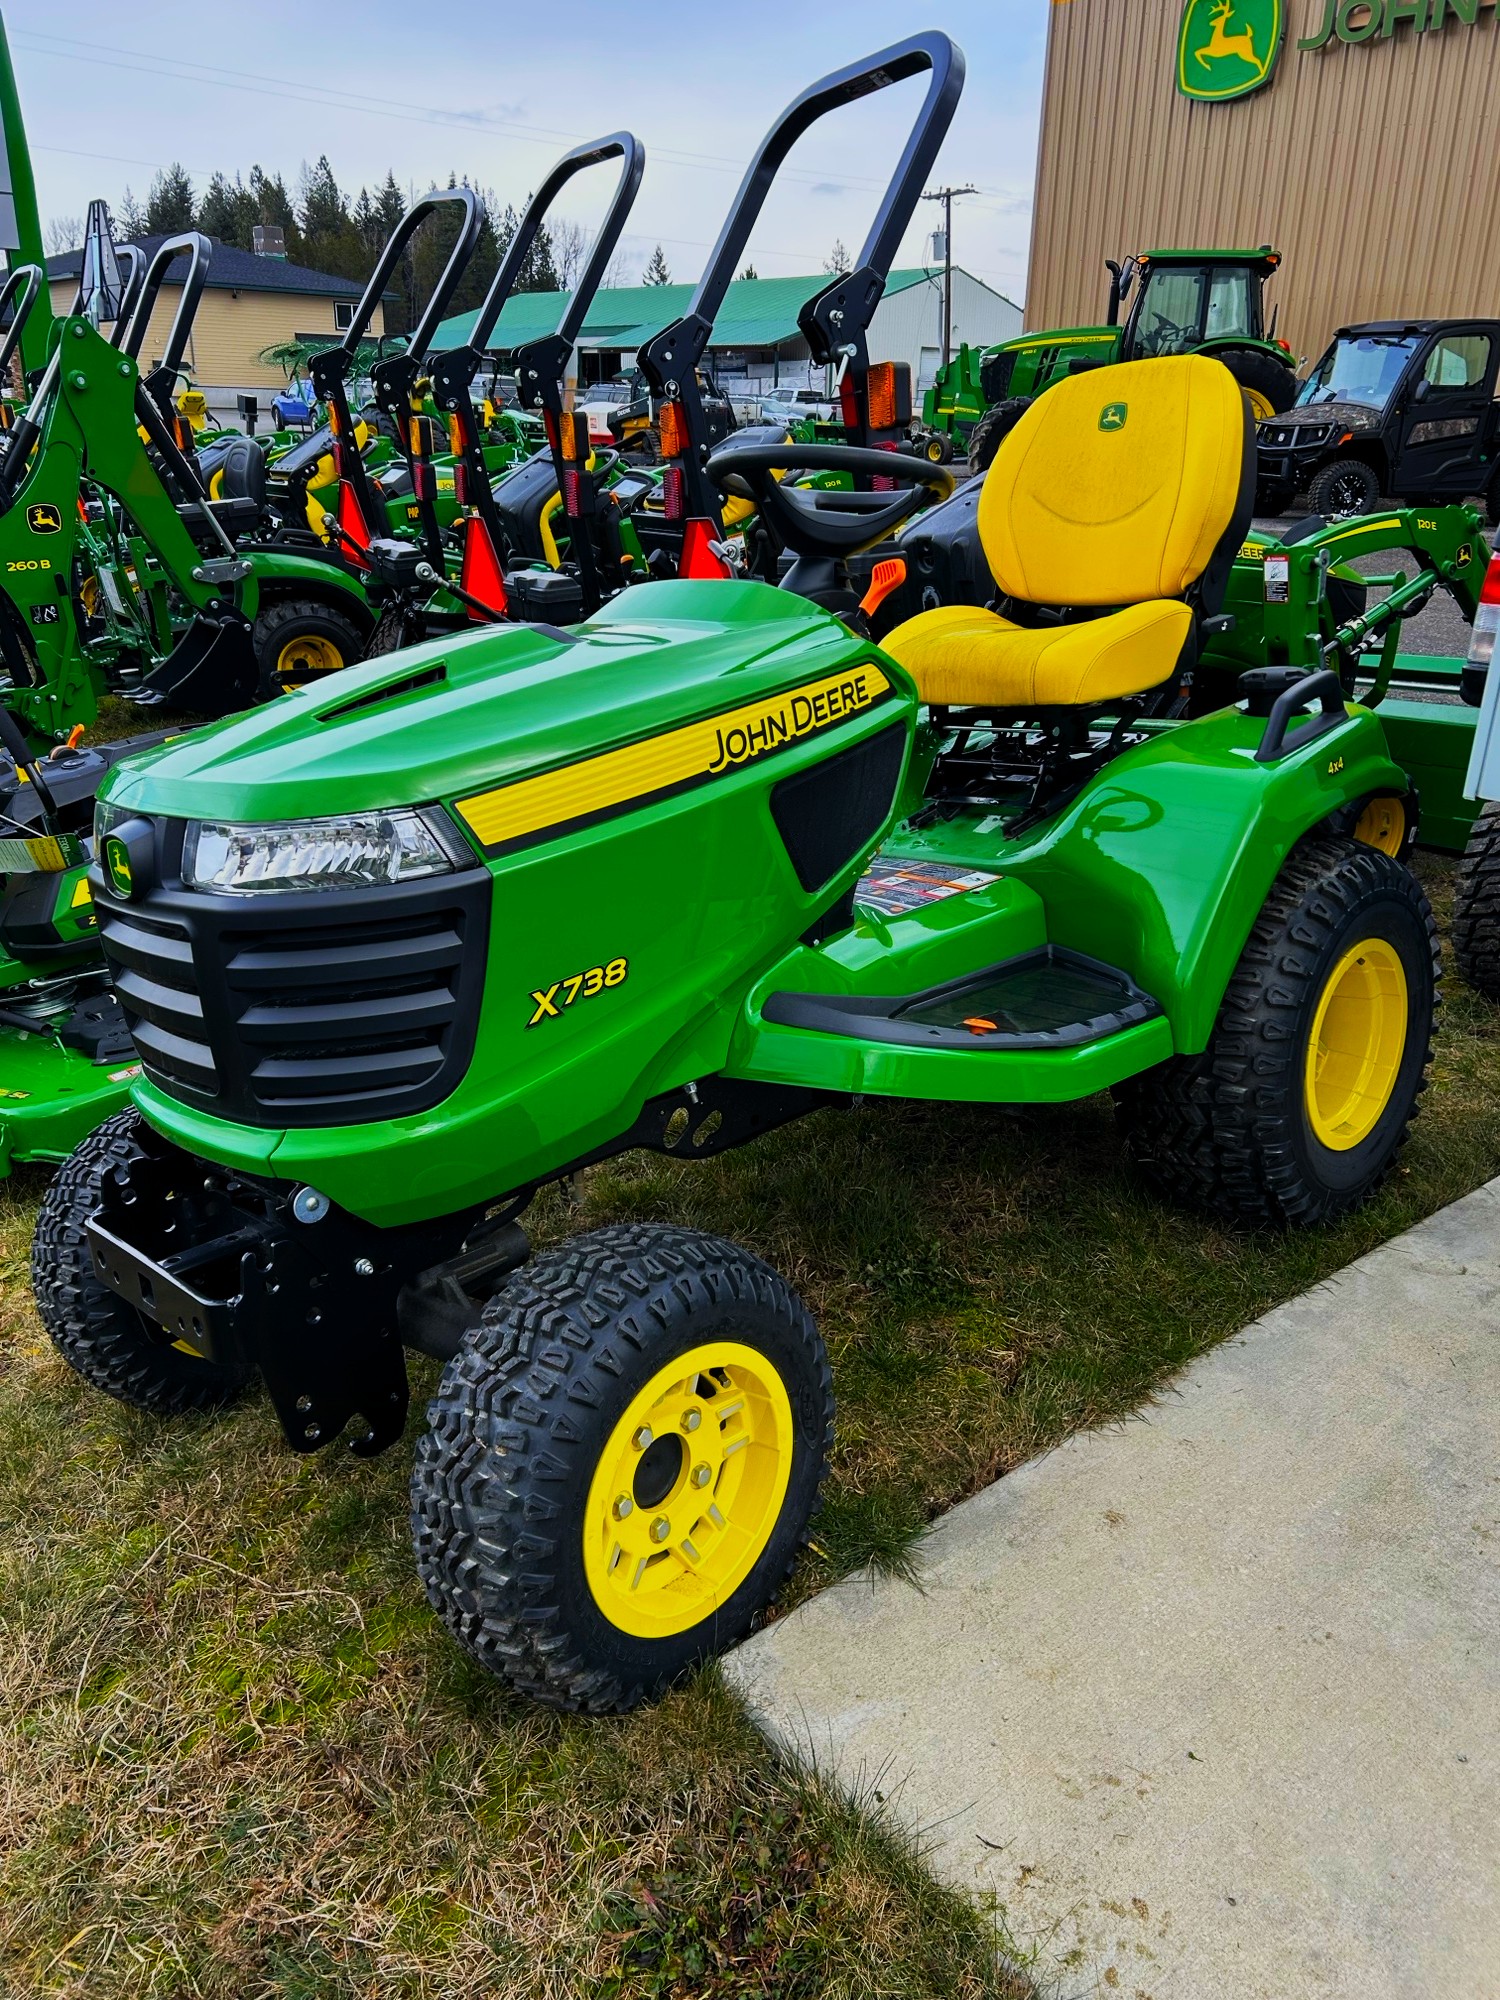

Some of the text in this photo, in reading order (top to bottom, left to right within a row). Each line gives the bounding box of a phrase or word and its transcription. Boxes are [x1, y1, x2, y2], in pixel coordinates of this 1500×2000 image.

[1297, 0, 1478, 50] JOHN
[6, 559, 52, 572] 260 B
[709, 674, 871, 771] JOHN DEERE
[1328, 756, 1344, 774] 4x4
[526, 957, 628, 1027] X738
